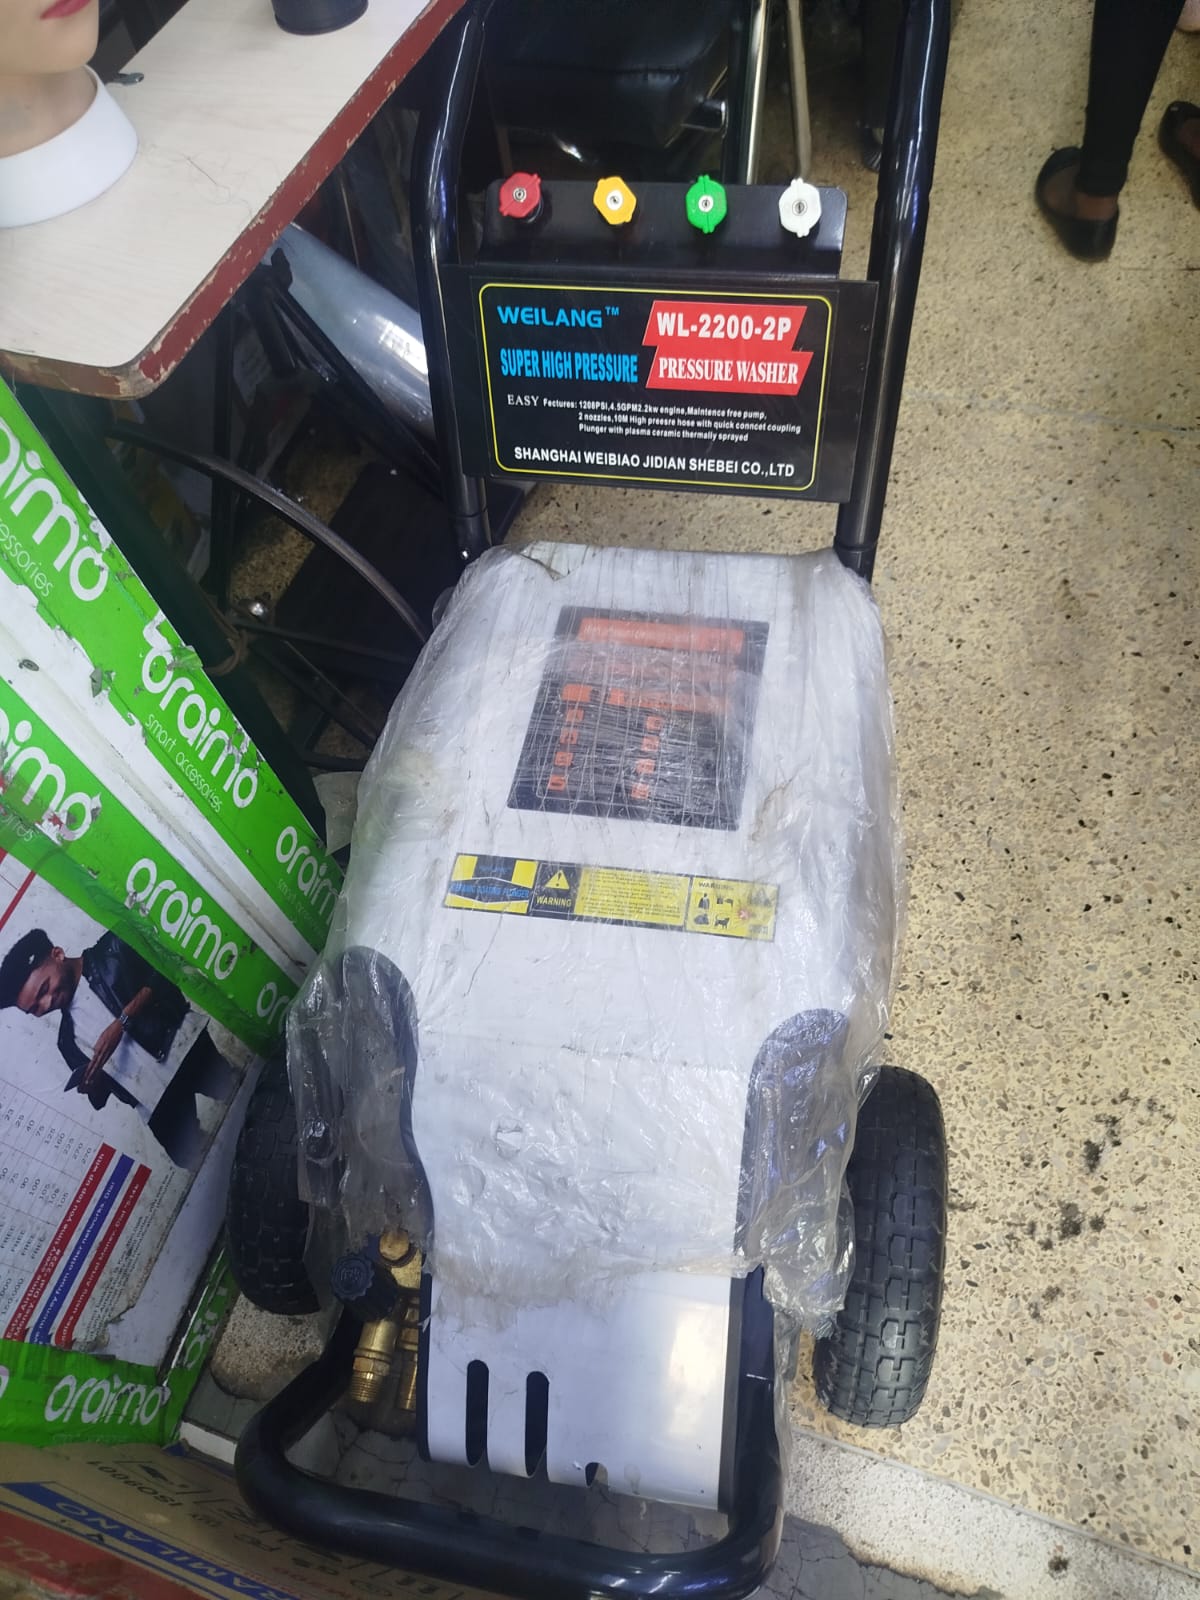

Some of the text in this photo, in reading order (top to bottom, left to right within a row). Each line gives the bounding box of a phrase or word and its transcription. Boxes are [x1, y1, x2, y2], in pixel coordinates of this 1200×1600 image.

[497, 305, 602, 328] WEILANG
[657, 312, 791, 341] WL-2200-2P
[500, 348, 638, 383] SUPER HIGH PRESSURE
[659, 357, 799, 384] PRESSURE WASHER
[507, 394, 539, 406] EASY
[726, 408, 741, 418] free
[743, 411, 767, 420] pump,
[578, 412, 583, 420] 2
[629, 415, 647, 425] High
[677, 418, 695, 427] hose
[696, 420, 712, 428] with
[713, 421, 734, 430] quick
[767, 424, 801, 435] coupling
[579, 423, 749, 443] Plunger with plasma ceramic thermally sprayed
[514, 446, 795, 477] SHANGHAI WEIBIAO JIDIAN SHEBEI CO.,LTD
[142, 650, 258, 809] oraimo
[145, 713, 223, 823] smart accessories
[276, 826, 338, 925] oraim
[535, 895, 572, 908] WARNING
[126, 858, 239, 981] oraimo
[26, 1120, 34, 1131] 40
[10, 1125, 43, 1183] 75 75
[20, 1128, 55, 1188] 90 125
[72, 1143, 82, 1158] 270
[82, 1148, 91, 1163] 270
[29, 1179, 39, 1194] 100
[39, 1183, 49, 1199] 105
[6, 1153, 104, 1337] Extra Airtime every time you top up with
[33, 1279, 45, 1297] Dial
[38, 1296, 57, 1328] money
[55, 1272, 69, 1294] from
[68, 1246, 82, 1270] other
[72, 1288, 87, 1313] using
[85, 1262, 100, 1286] Airtel
[44, 1374, 172, 1426] oraimo
